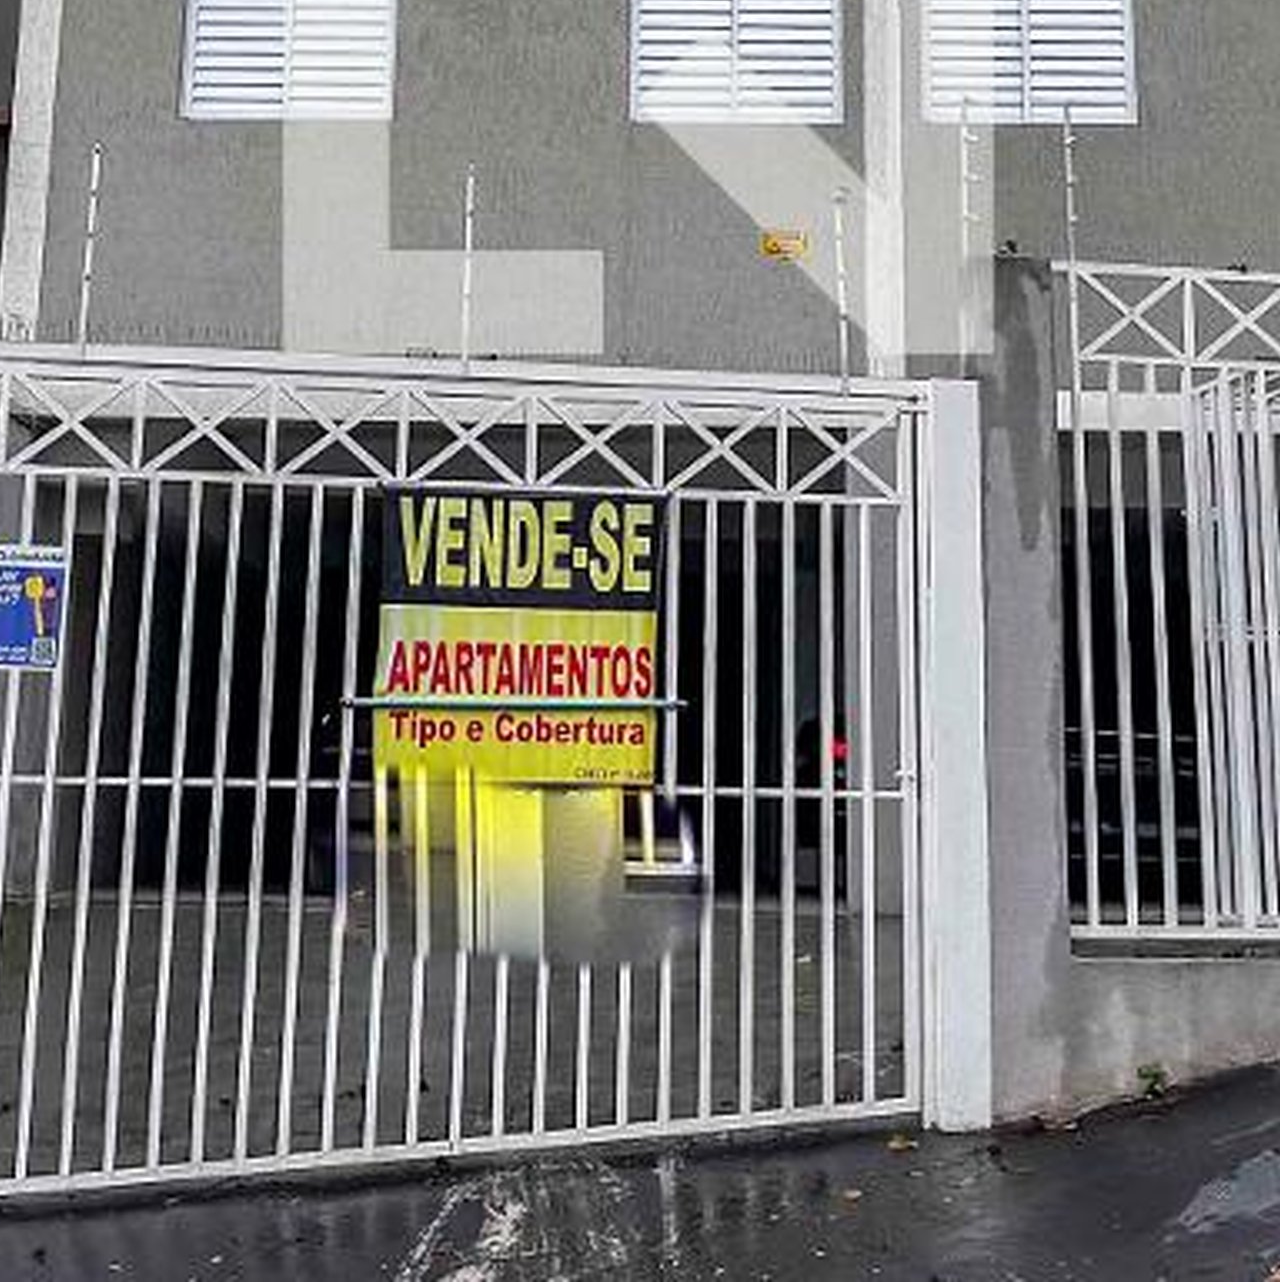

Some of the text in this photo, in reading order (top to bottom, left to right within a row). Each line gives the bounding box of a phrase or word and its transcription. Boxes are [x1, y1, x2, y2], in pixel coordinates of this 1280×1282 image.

[400, 496, 654, 593] VENDE-SE
[387, 640, 652, 698] APARTAMENTOS
[389, 712, 646, 747] Tipo e Cobertura
